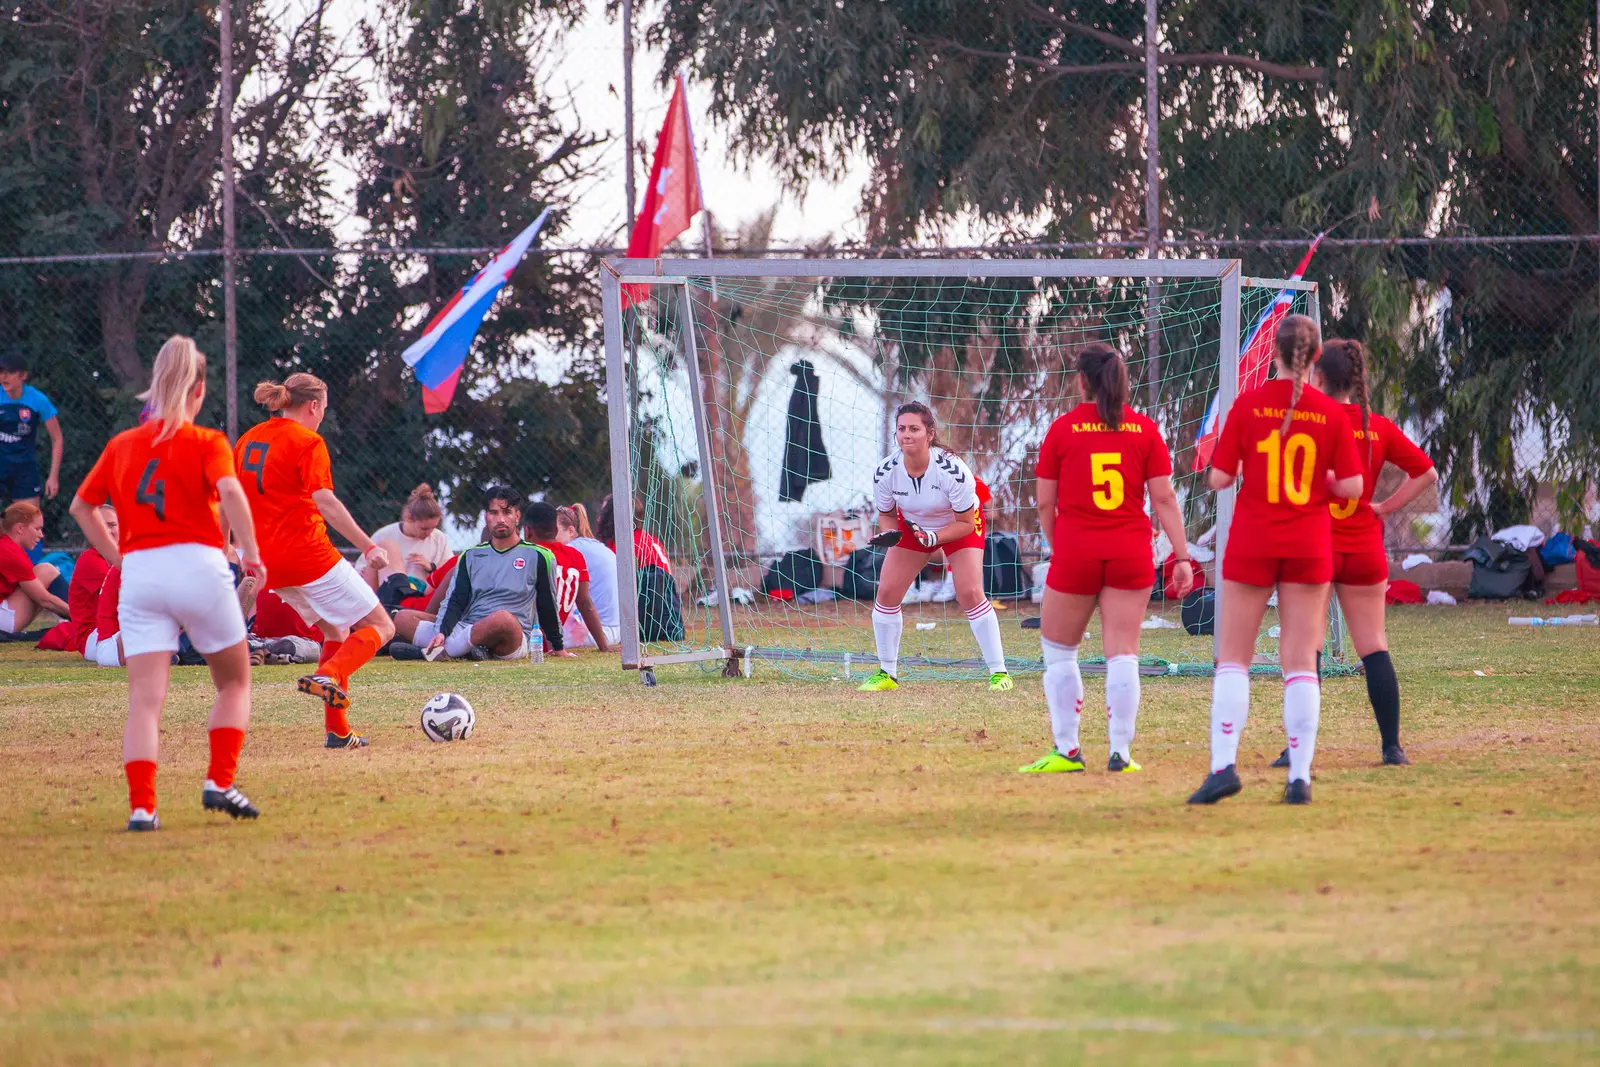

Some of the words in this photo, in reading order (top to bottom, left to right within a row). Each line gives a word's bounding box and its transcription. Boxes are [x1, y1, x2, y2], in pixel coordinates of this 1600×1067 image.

[135, 457, 166, 521] 4
[243, 440, 270, 495] 9
[1090, 452, 1125, 511] 5
[1256, 429, 1317, 505] 10
